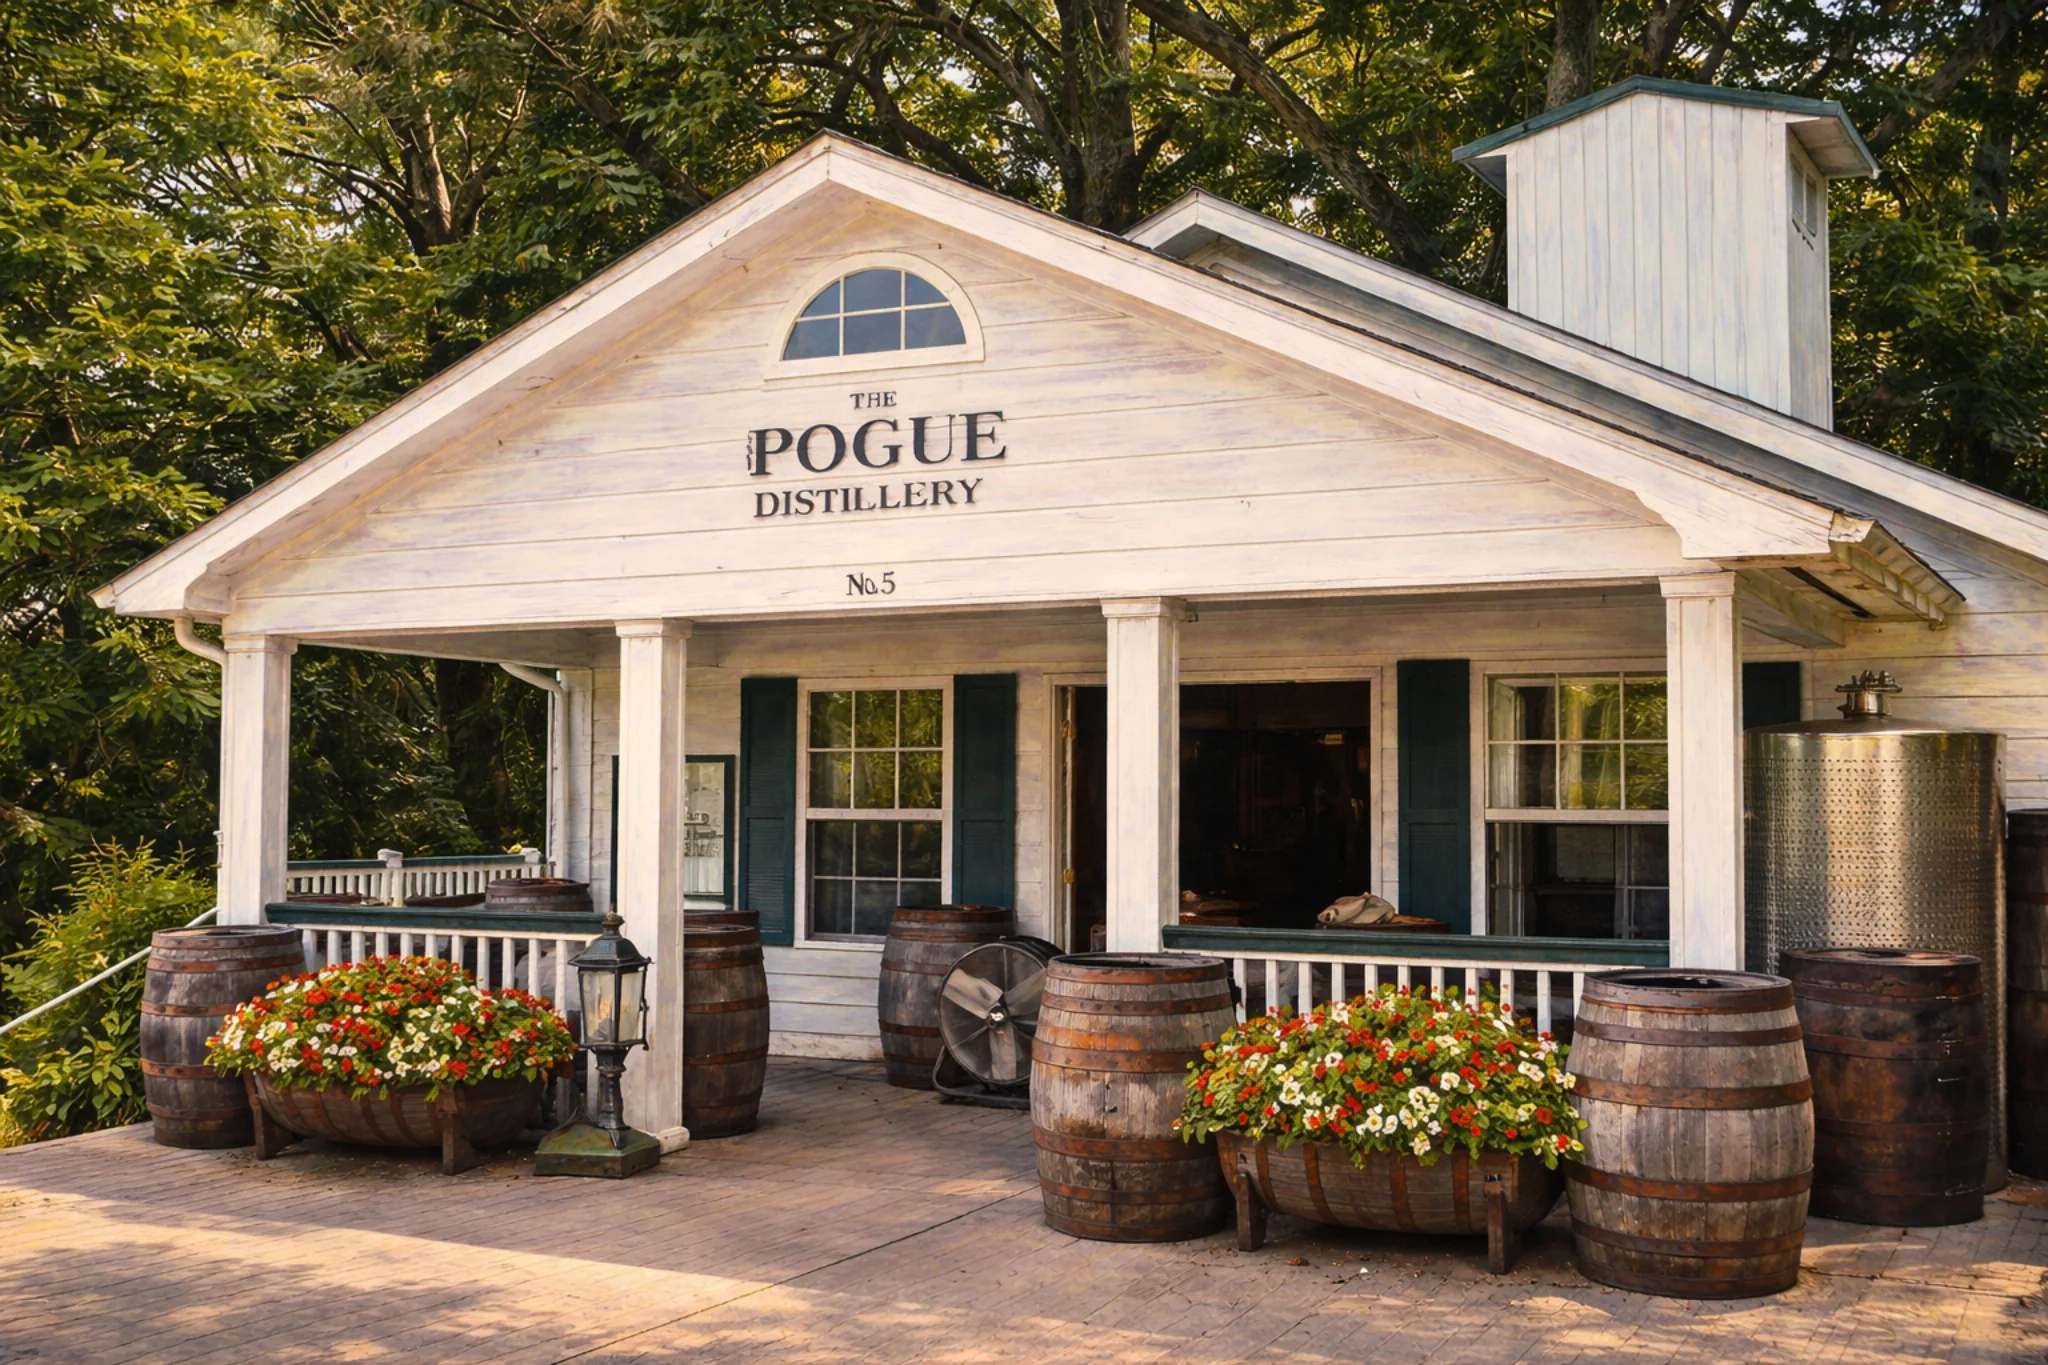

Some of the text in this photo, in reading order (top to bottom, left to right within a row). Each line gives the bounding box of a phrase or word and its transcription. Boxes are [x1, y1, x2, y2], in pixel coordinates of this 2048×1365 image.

[850, 391, 897, 409] THE
[748, 411, 1006, 476] POGUE
[754, 478, 983, 518] DISTILLERY
